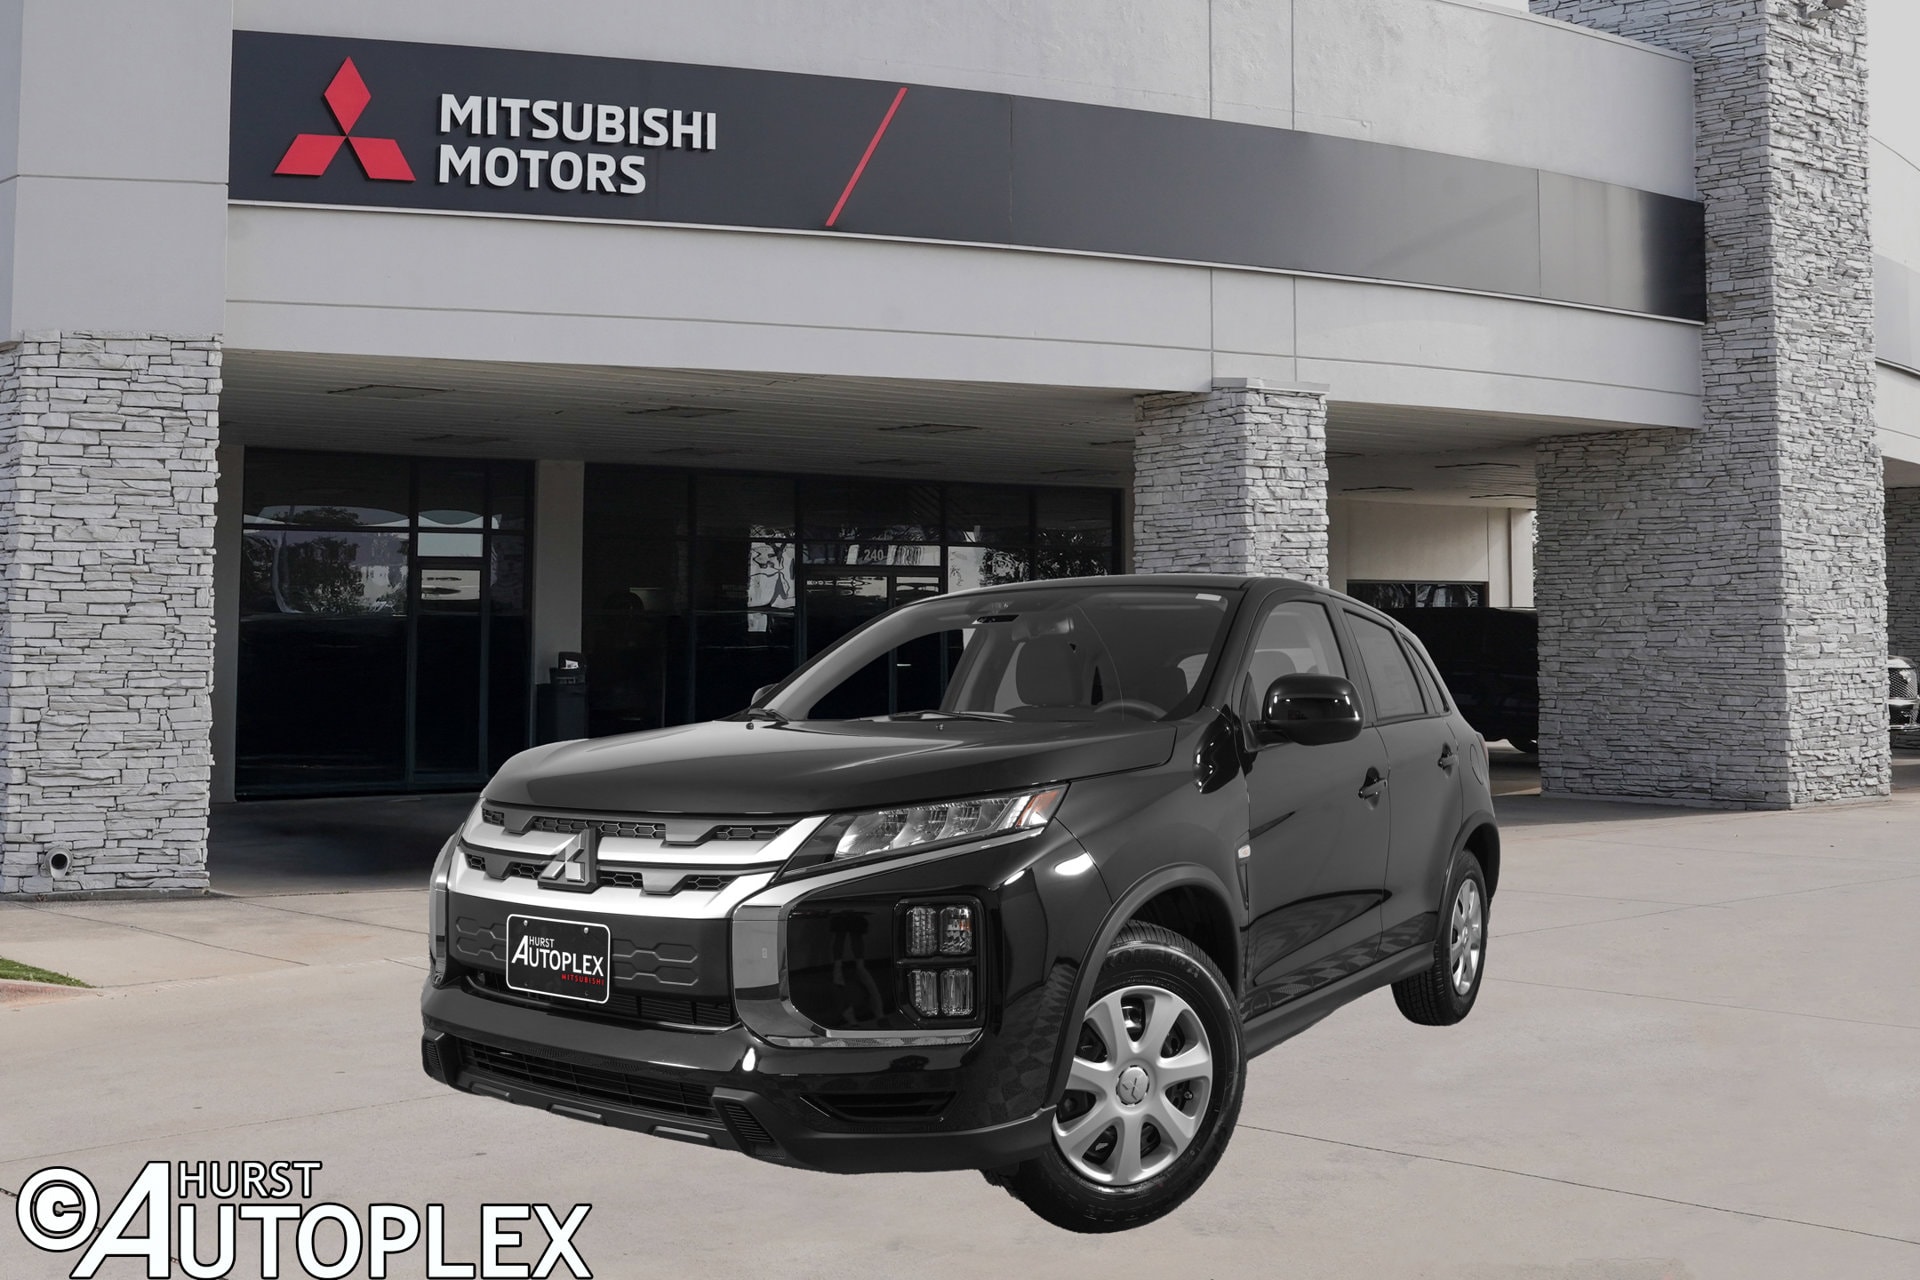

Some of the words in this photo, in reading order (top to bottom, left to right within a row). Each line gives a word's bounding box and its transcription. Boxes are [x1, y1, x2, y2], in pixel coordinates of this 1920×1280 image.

[439, 92, 717, 152] MITSUBISHI
[437, 144, 647, 196] MOTORS
[863, 548, 884, 561] 240
[511, 935, 604, 977] AUTOPLEX
[529, 935, 555, 949] HURST
[561, 973, 605, 986] MITSUBISHI
